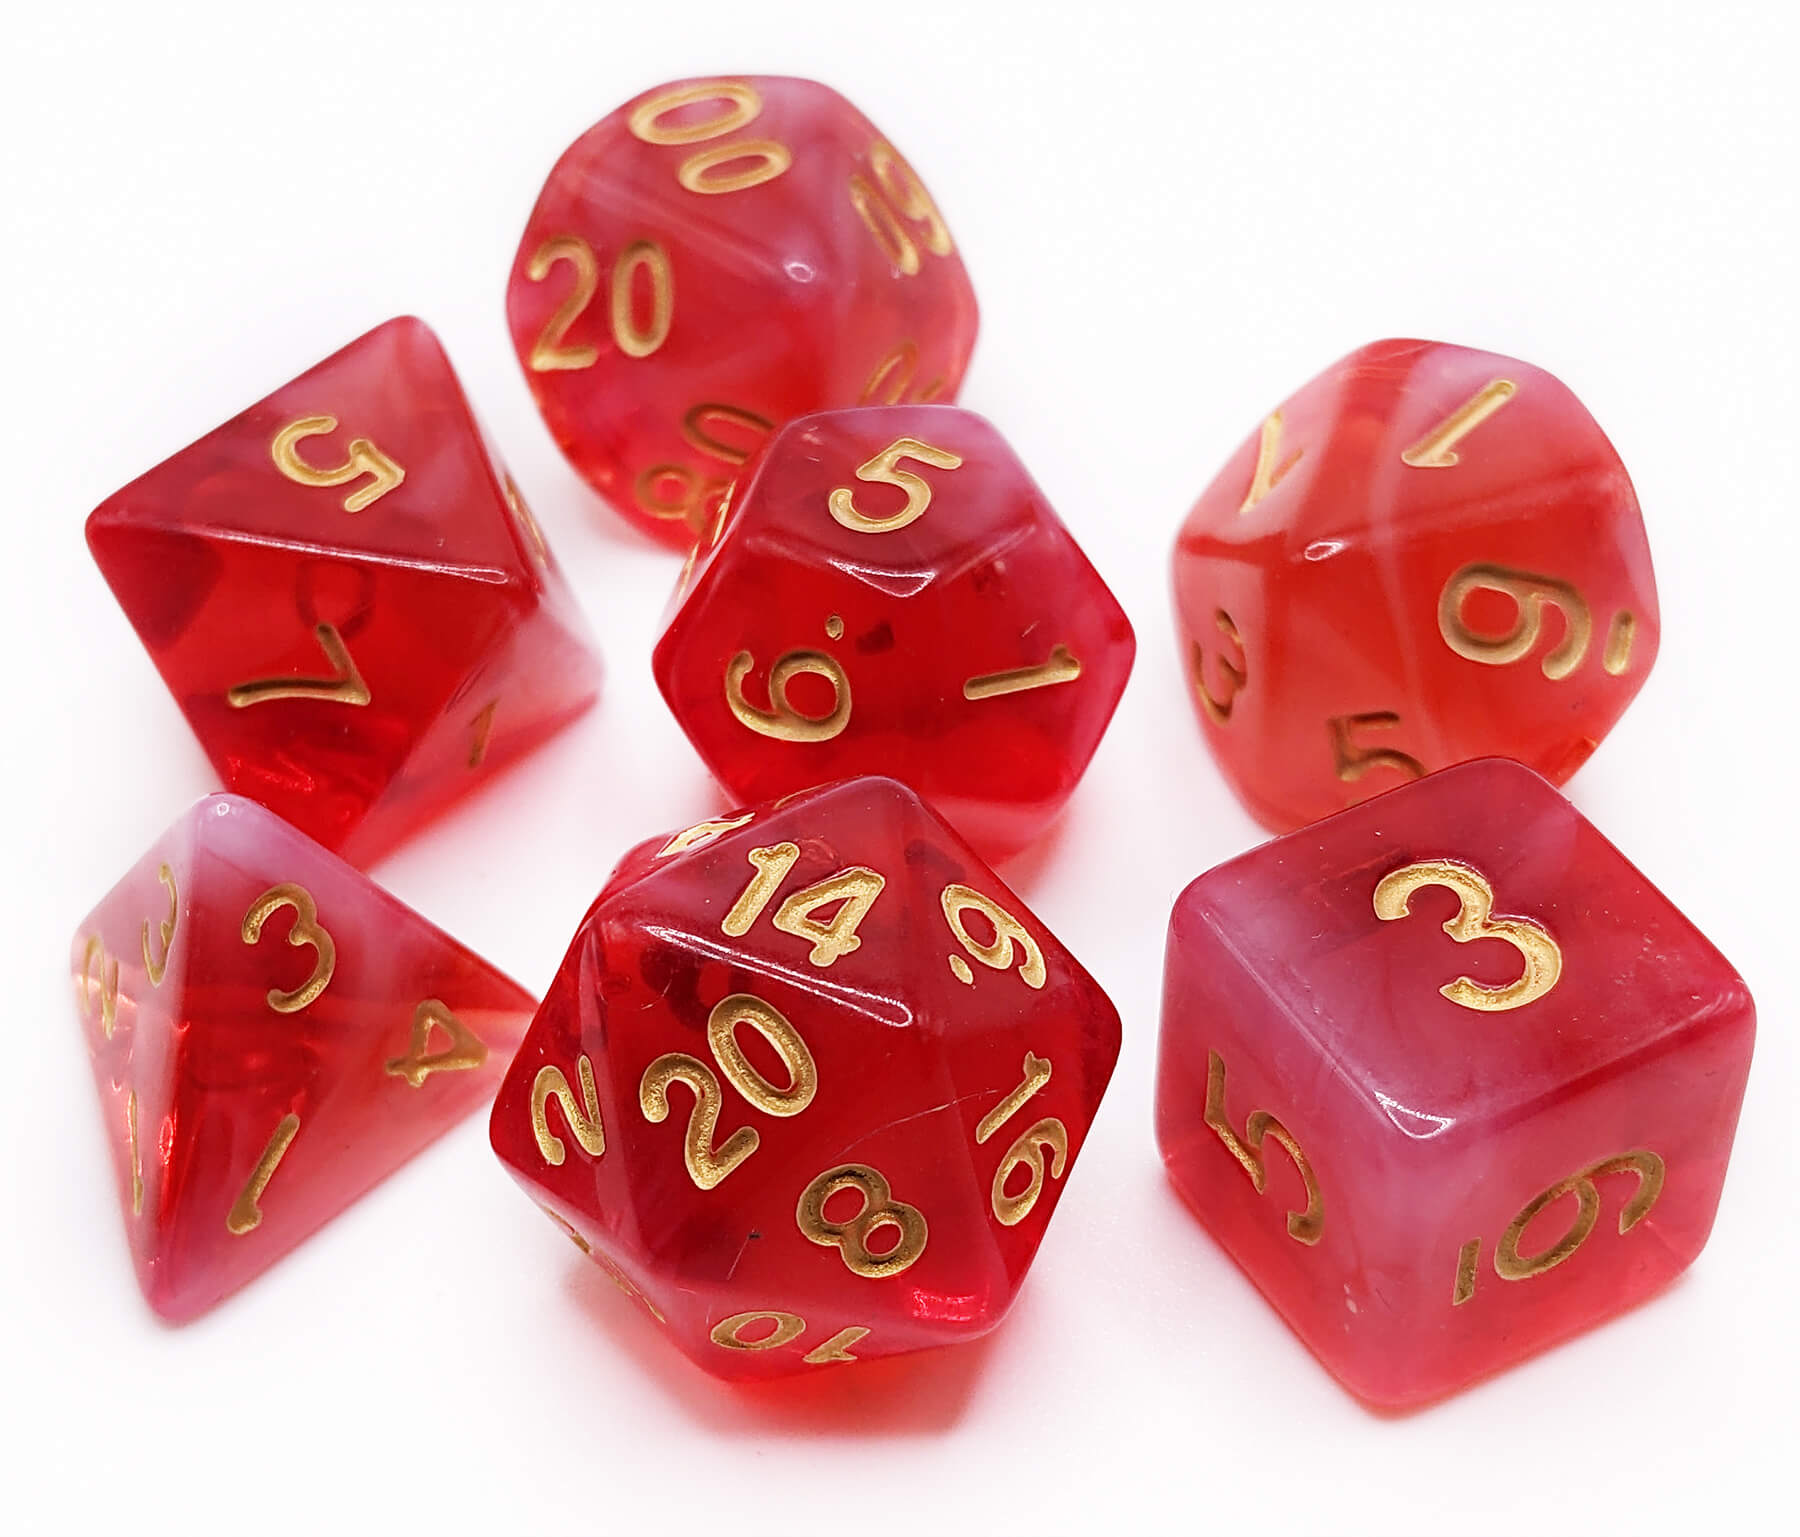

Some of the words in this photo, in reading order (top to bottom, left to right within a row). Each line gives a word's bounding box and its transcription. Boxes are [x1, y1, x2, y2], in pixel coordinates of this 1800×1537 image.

[630, 82, 793, 195] 00
[526, 236, 675, 373] 20
[272, 413, 405, 512] 5
[1402, 380, 1517, 467] 1
[828, 437, 963, 534] 5
[227, 622, 371, 708] 7
[964, 642, 1081, 701] 1
[1192, 606, 1248, 727] 3
[241, 882, 336, 1013] 3
[721, 842, 885, 967] 14
[1372, 858, 1563, 1012] 3
[386, 999, 489, 1087] 4
[640, 993, 818, 1190] 20
[530, 1054, 606, 1166] 2
[976, 1050, 1069, 1227] 16
[1203, 1049, 1325, 1245] 5
[226, 1113, 300, 1235] 1
[796, 1163, 928, 1278] 8
[711, 1311, 871, 1363] 10
